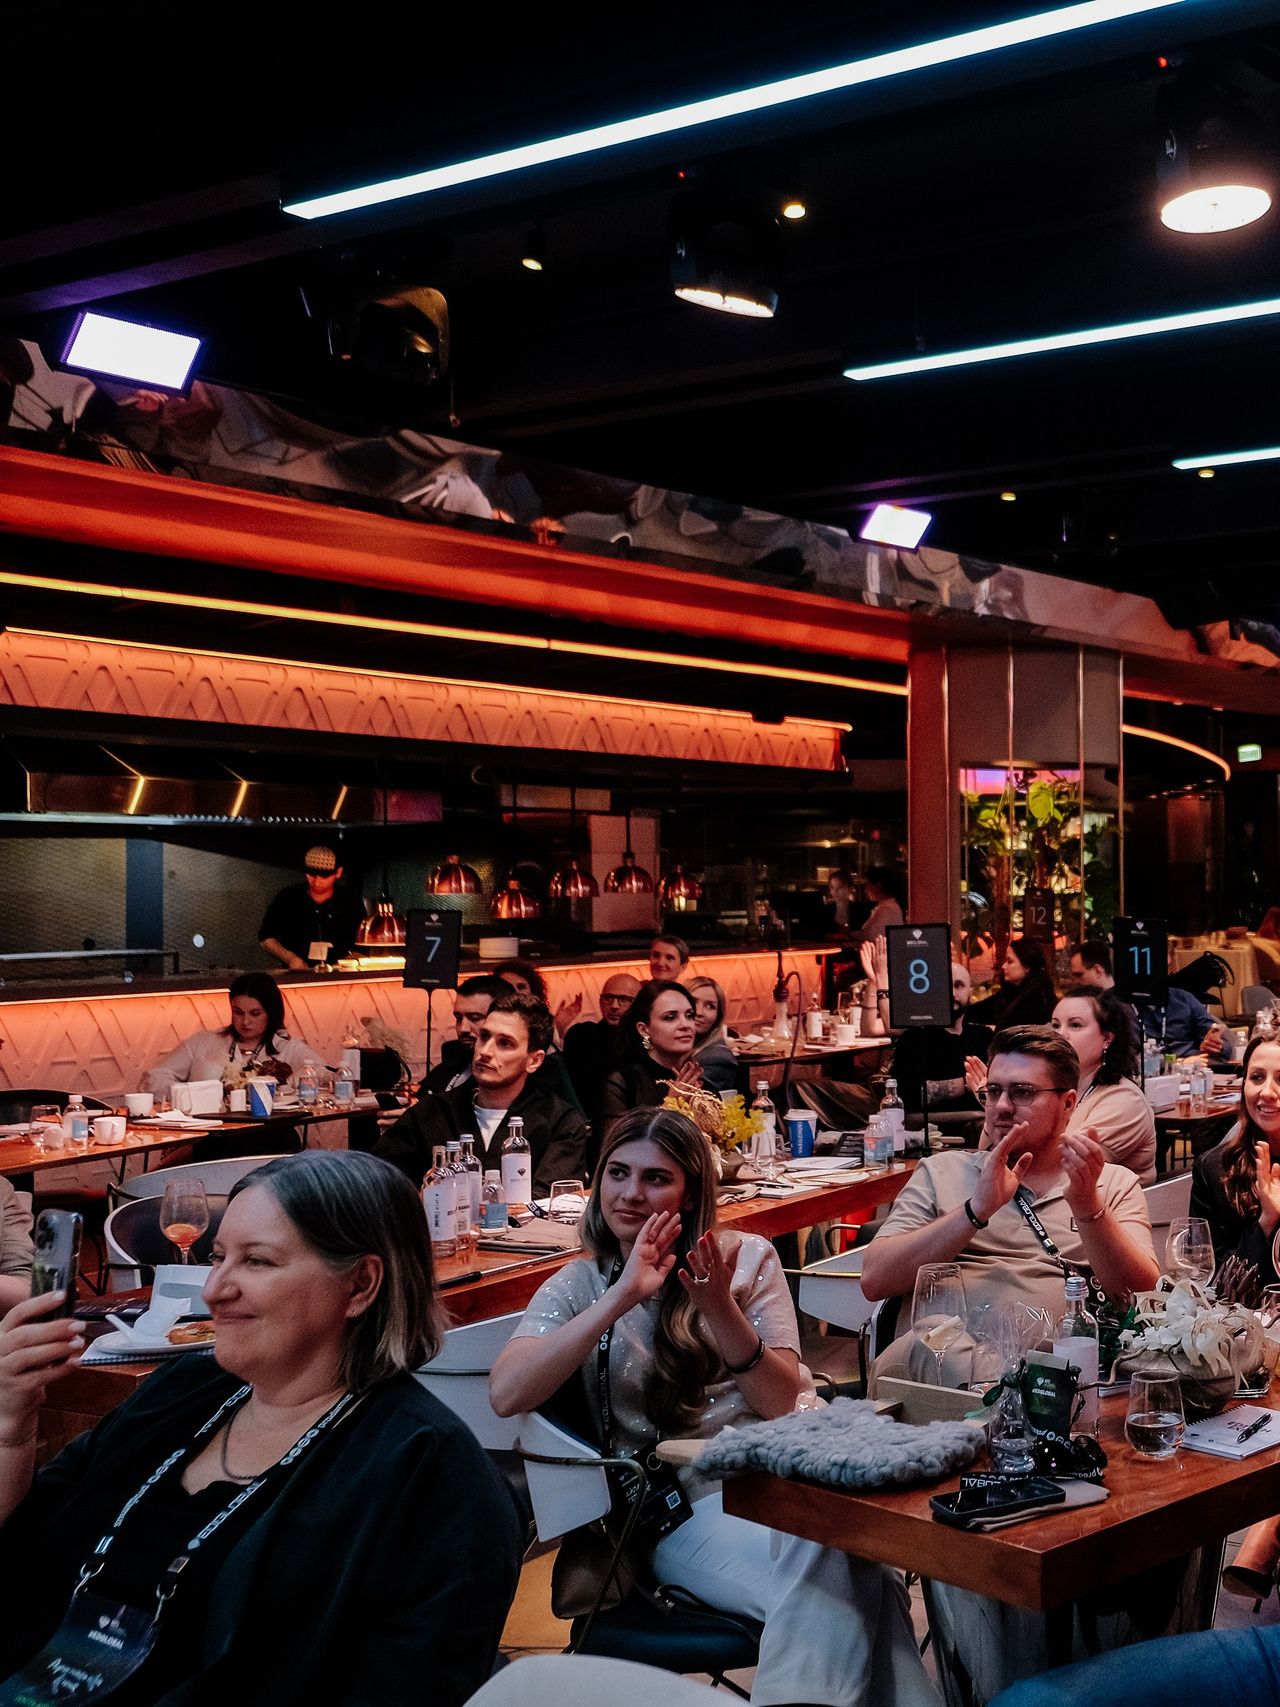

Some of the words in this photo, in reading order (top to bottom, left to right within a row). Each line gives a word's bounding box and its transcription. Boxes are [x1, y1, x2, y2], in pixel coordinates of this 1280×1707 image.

[1030, 906, 1047, 925] 12
[425, 936, 441, 963] 7
[1128, 946, 1151, 975] 11
[909, 959, 930, 994] 8
[1017, 1196, 1043, 1231] EDGLOBAL
